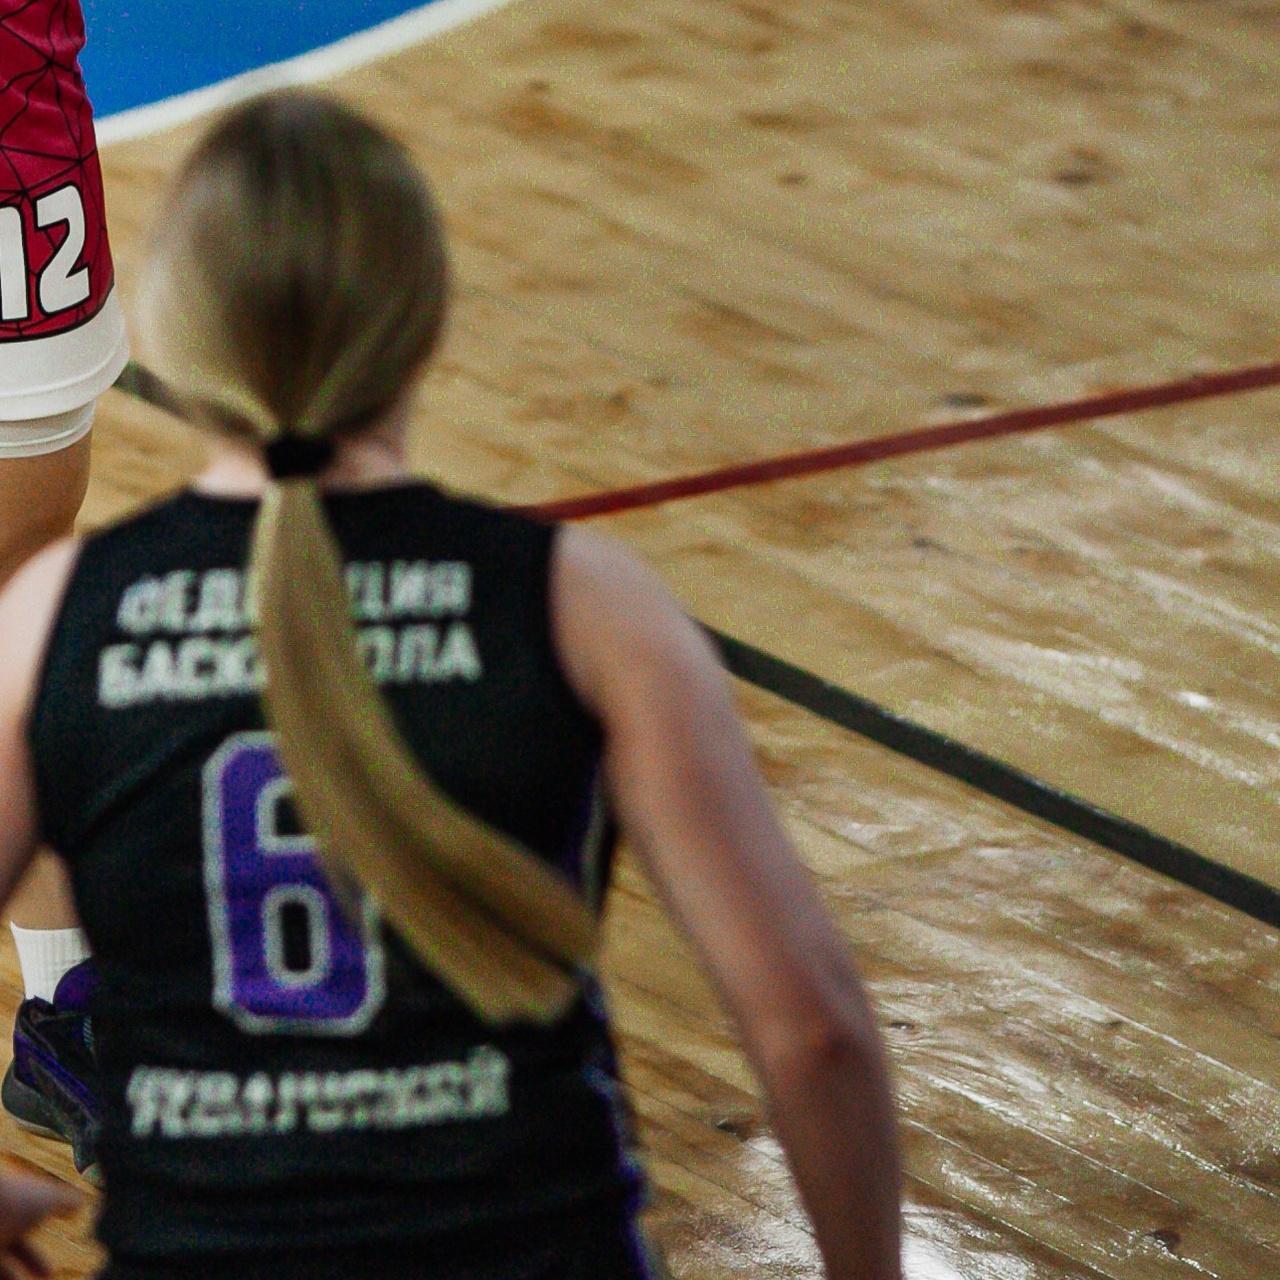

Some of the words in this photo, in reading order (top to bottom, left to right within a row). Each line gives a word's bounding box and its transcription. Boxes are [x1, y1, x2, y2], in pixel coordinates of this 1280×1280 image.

[117, 560, 474, 634] ФЕДЦИЯ
[98, 623, 483, 710] БАСКОЛА
[201, 731, 386, 1036] 6
